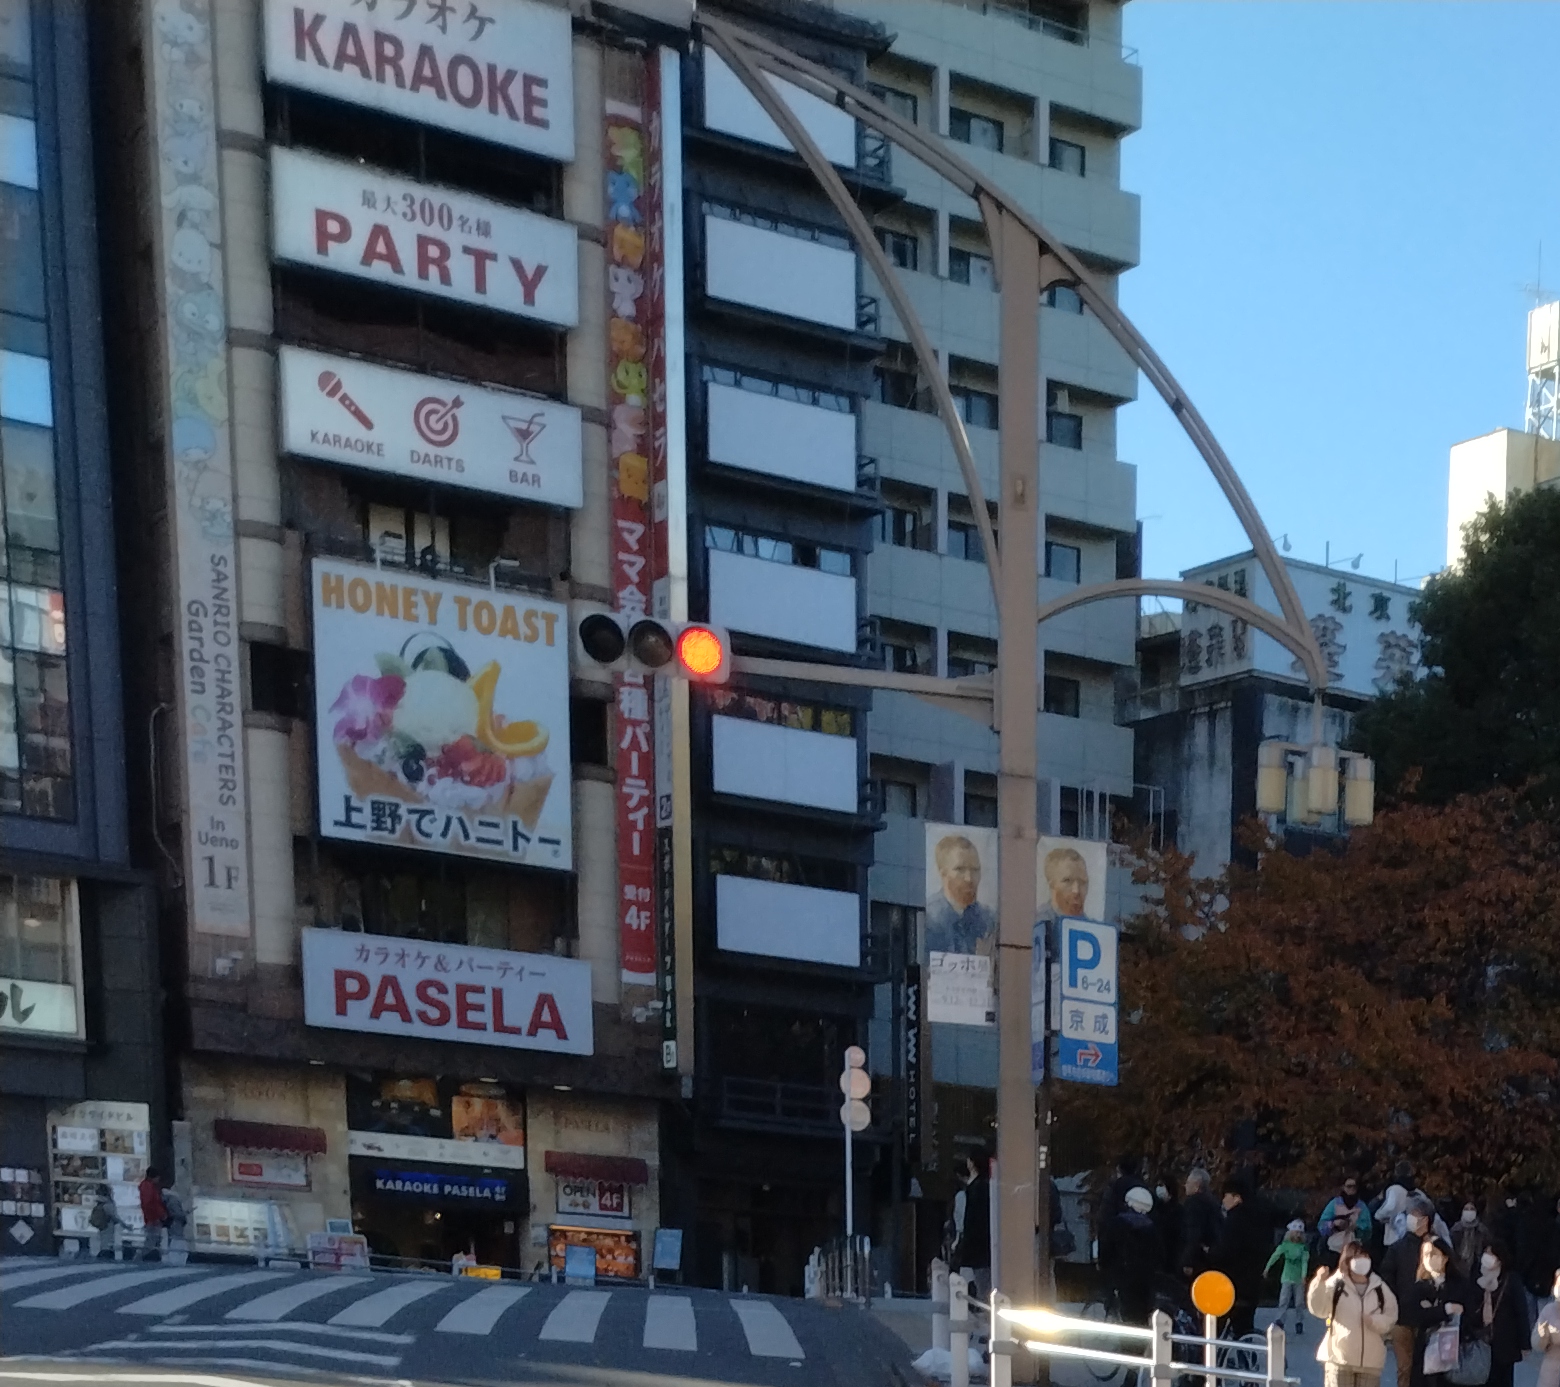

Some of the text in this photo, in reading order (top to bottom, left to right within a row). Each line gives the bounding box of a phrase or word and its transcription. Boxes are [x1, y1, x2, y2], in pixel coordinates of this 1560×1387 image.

[293, 7, 550, 130] KARAOKE
[361, 188, 492, 239] 最大300名様
[314, 207, 549, 307] PARTY
[310, 430, 541, 488] KARAOKE DARTS BAR
[321, 572, 559, 646] HONEY TOAST
[186, 599, 210, 696] Garden
[211, 553, 237, 807] SANRIO CHARACTERS
[198, 831, 240, 850] Ueno
[333, 794, 562, 852] 上野でハニトー
[202, 855, 240, 891] 1F
[625, 905, 651, 931] 4F
[1068, 928, 1101, 988] P
[333, 968, 569, 1041] PASELA
[1069, 1008, 1109, 1035] 京成
[375, 1178, 440, 1194] KARAOKE
[444, 1184, 493, 1199] PASELA
